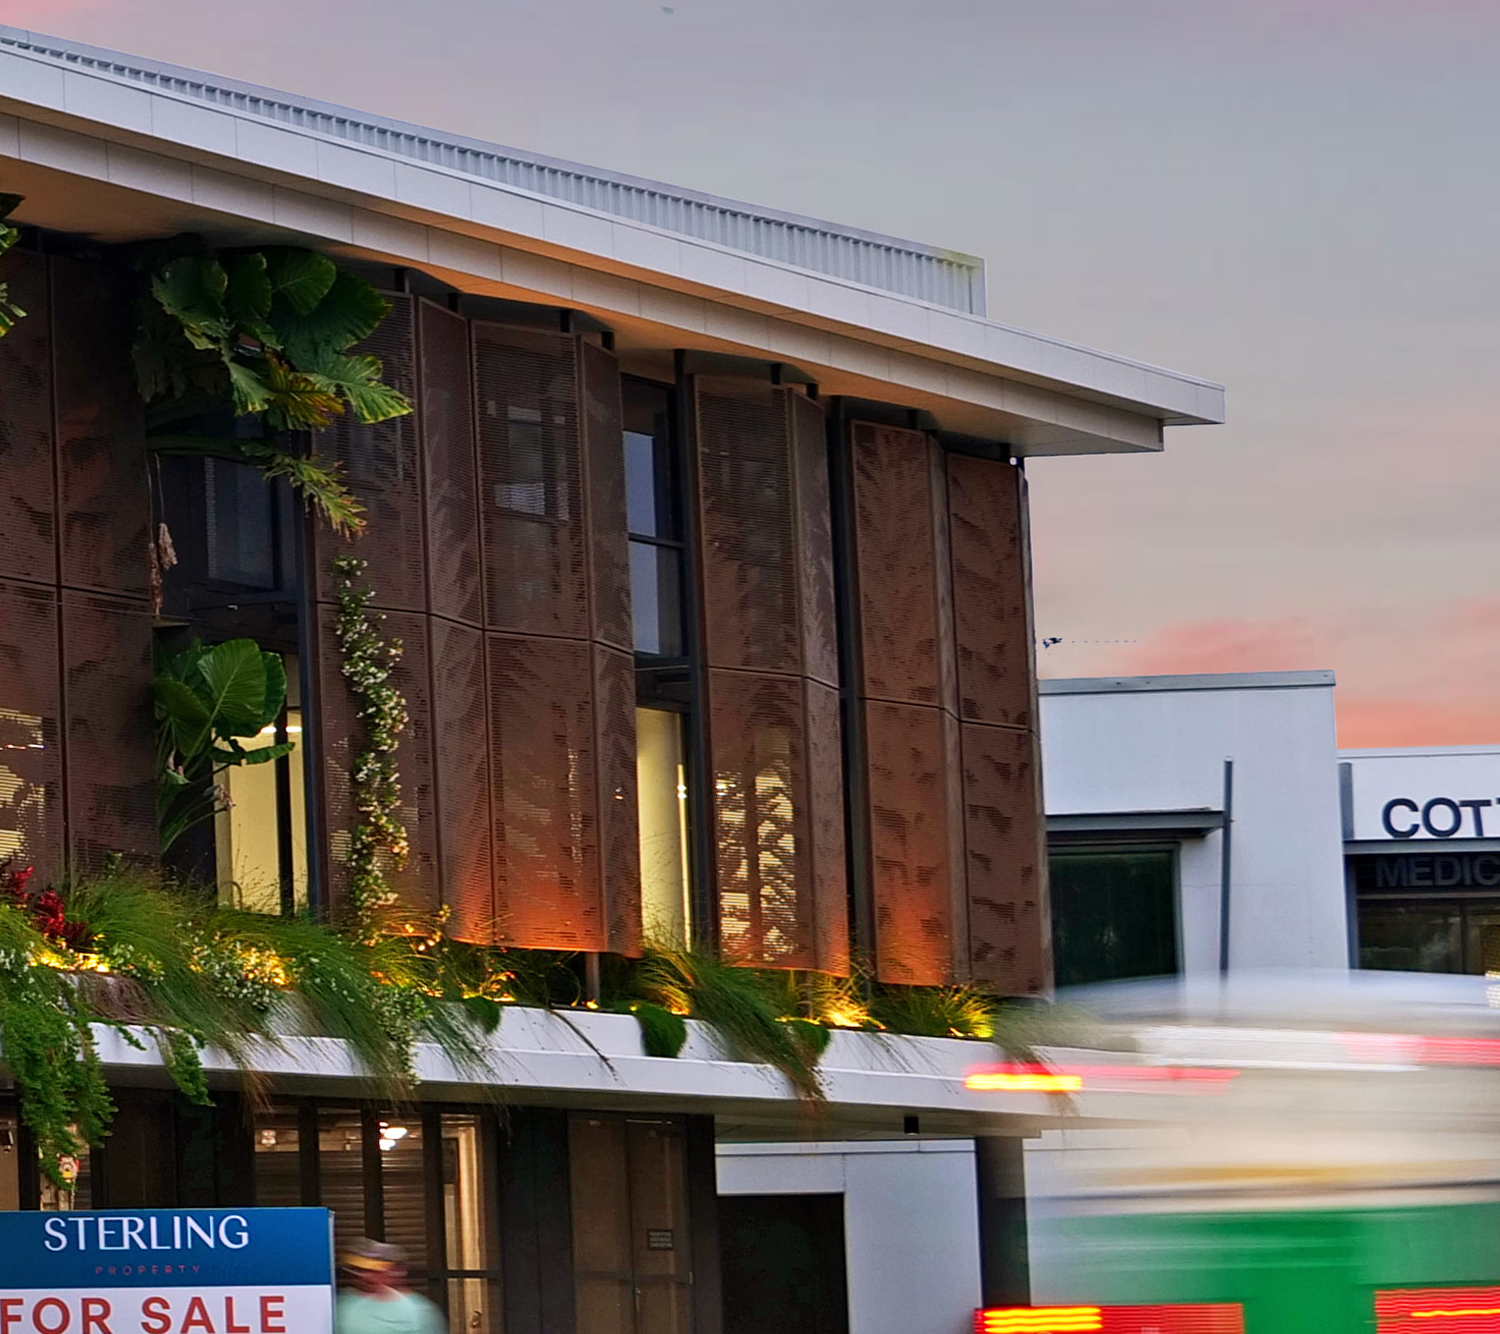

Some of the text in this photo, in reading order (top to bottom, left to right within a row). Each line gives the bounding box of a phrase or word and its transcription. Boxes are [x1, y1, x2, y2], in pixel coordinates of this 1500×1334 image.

[1382, 797, 1500, 838] COT
[43, 1214, 250, 1251] STERLING
[94, 1264, 200, 1276] PROPERTY
